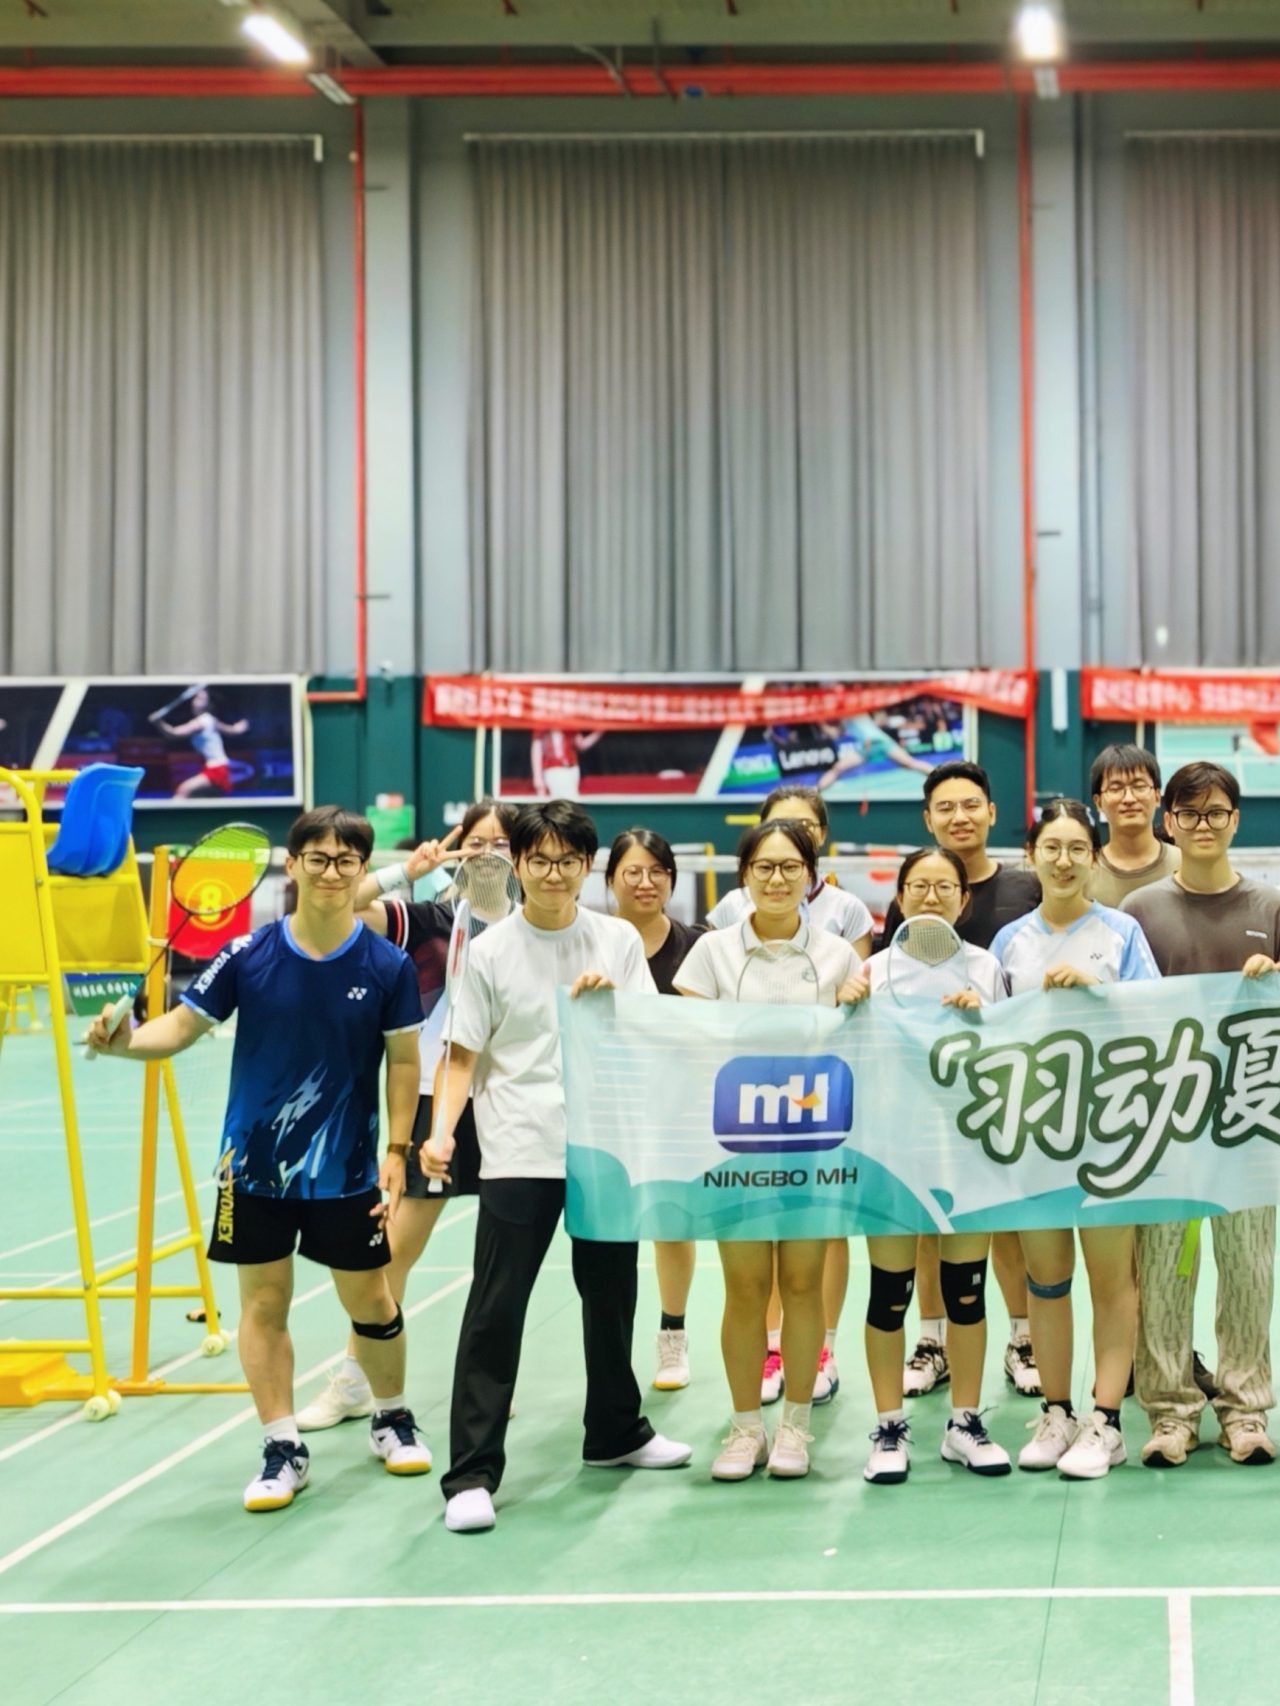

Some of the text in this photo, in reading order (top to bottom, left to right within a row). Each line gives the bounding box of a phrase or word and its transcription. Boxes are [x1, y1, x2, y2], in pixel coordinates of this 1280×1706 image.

[200, 884, 221, 923] 8
[193, 951, 231, 995] YONEX
[703, 1167, 858, 1188] NINGBO MH
[217, 1184, 235, 1245] YONEX
